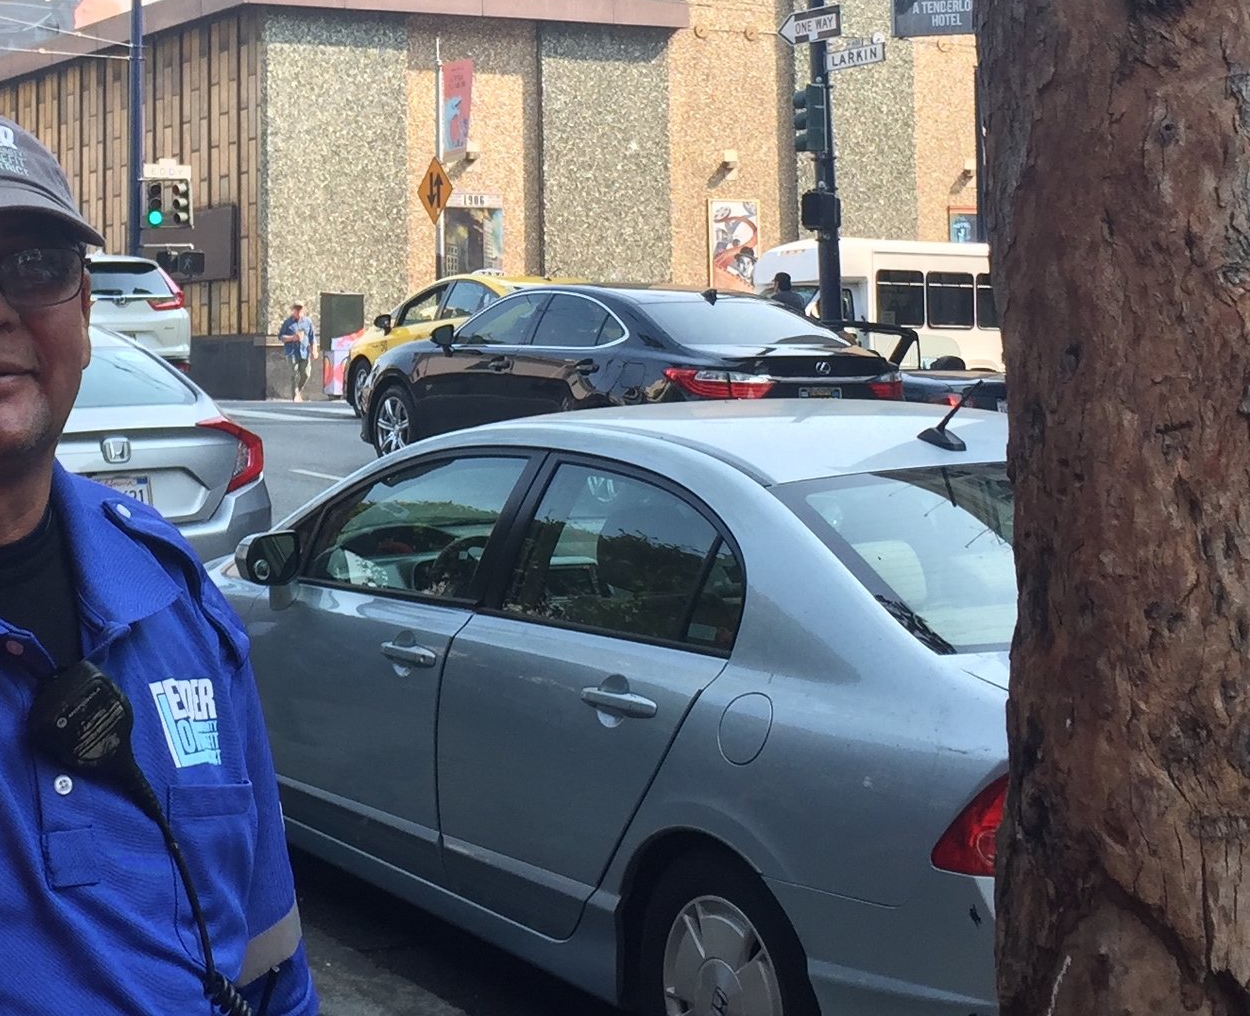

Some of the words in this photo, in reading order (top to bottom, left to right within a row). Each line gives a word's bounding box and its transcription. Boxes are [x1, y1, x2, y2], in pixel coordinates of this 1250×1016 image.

[912, 1, 920, 14] A
[795, 20, 812, 35] ONE
[815, 15, 834, 30] WAY
[931, 14, 962, 27] HOTEL
[831, 47, 878, 67] LARKIN
